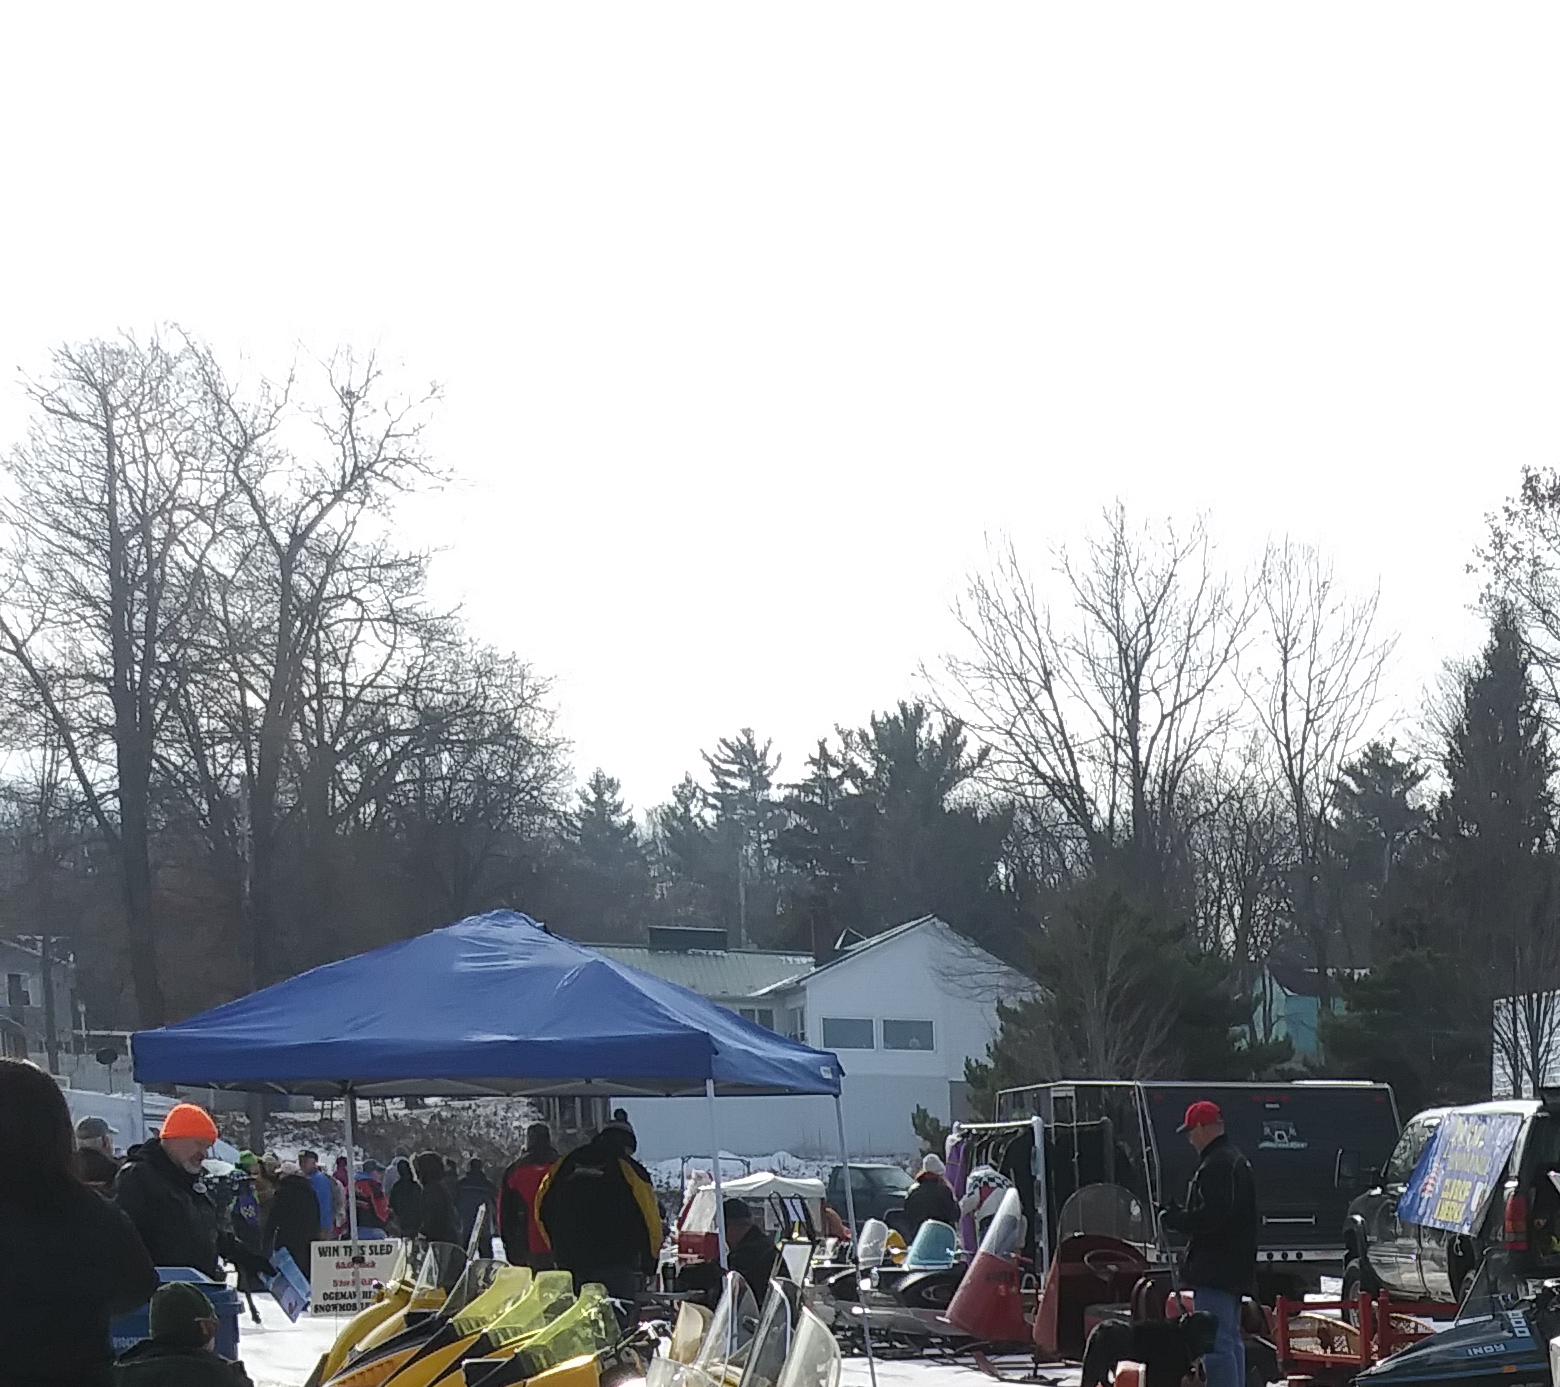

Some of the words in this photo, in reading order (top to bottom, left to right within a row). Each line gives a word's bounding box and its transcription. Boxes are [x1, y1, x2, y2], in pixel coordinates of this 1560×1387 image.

[318, 1246, 339, 1257] WIN
[369, 1244, 393, 1256] SLED
[1467, 1343, 1506, 1357] INDY
